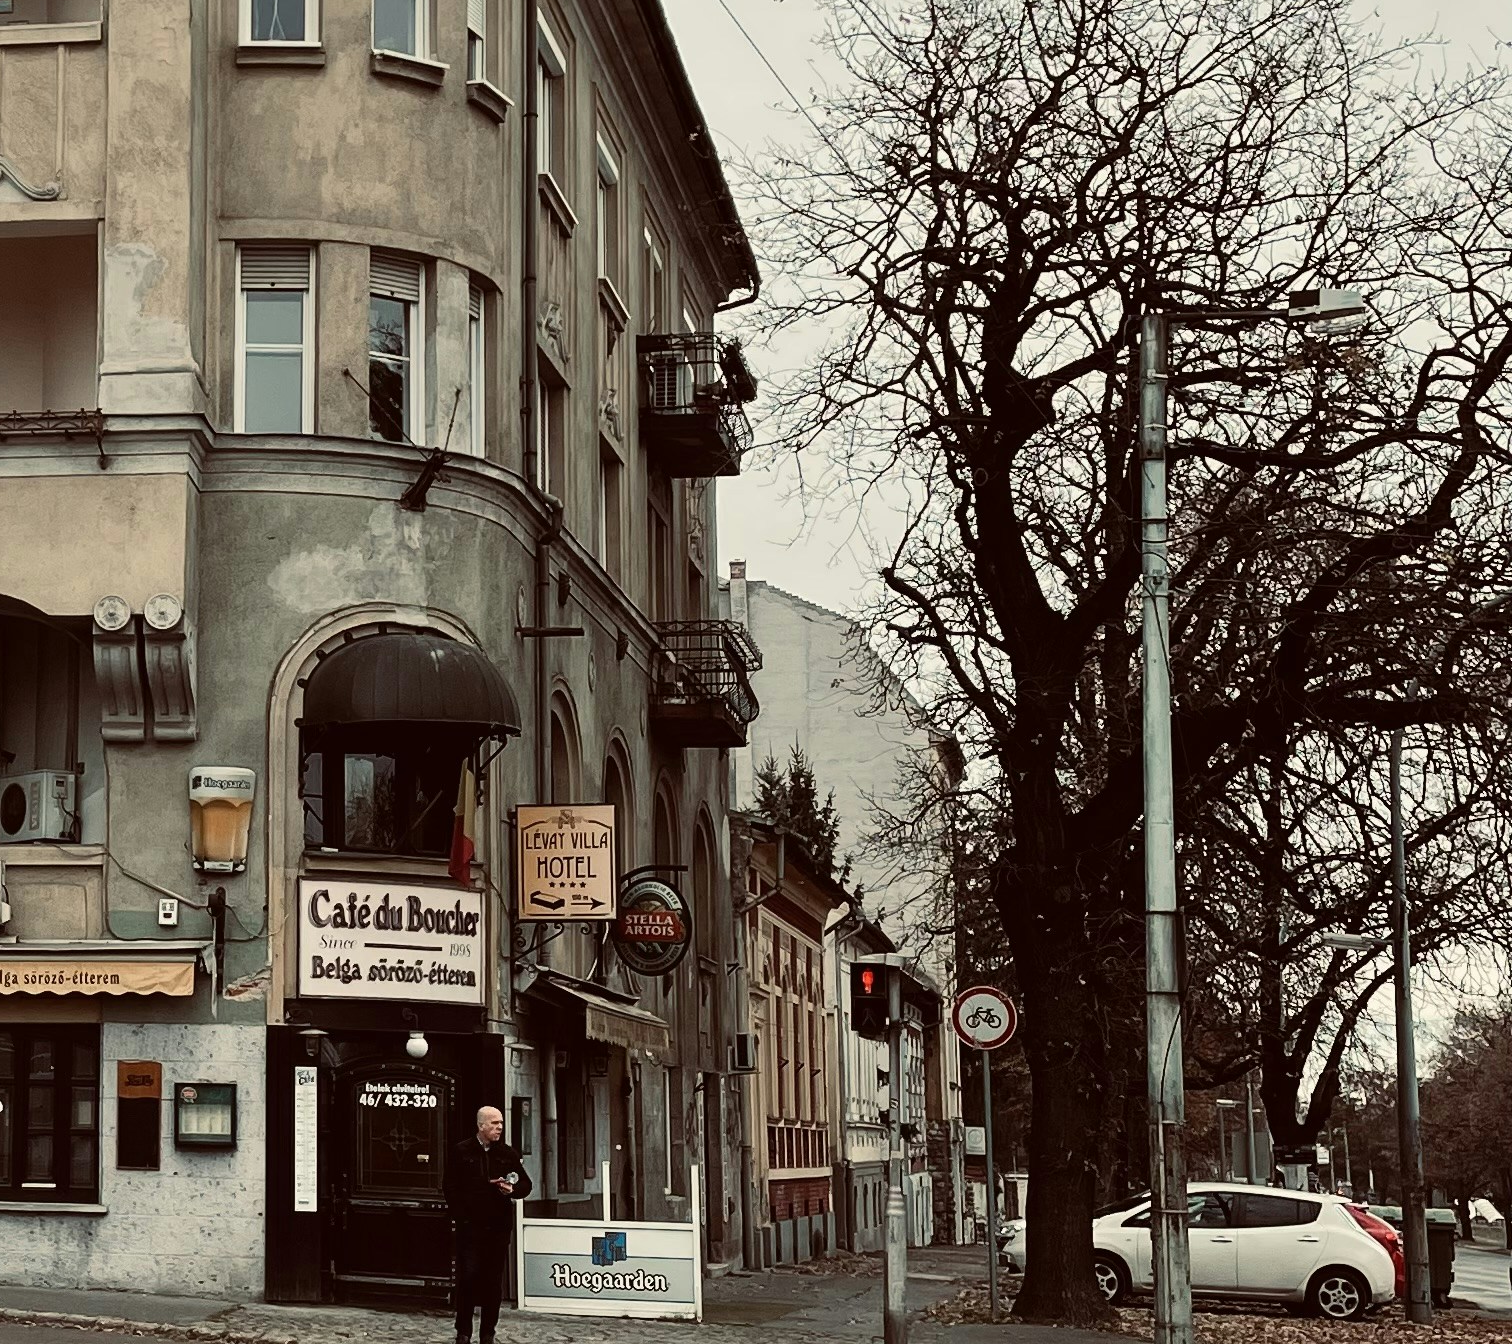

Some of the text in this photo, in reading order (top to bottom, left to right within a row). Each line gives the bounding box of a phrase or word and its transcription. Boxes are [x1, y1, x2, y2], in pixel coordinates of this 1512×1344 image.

[525, 829, 608, 850] LÉVAY VILLA
[537, 856, 597, 879] HOTEL
[308, 889, 480, 937] Café du Boucher
[624, 914, 674, 925] STELLA
[624, 925, 675, 937] ARTOIS
[319, 934, 357, 950] Since
[310, 955, 363, 984] Belga
[359, 1093, 437, 1108] 46/ 432-320
[550, 1263, 668, 1294] Hoegaarden
